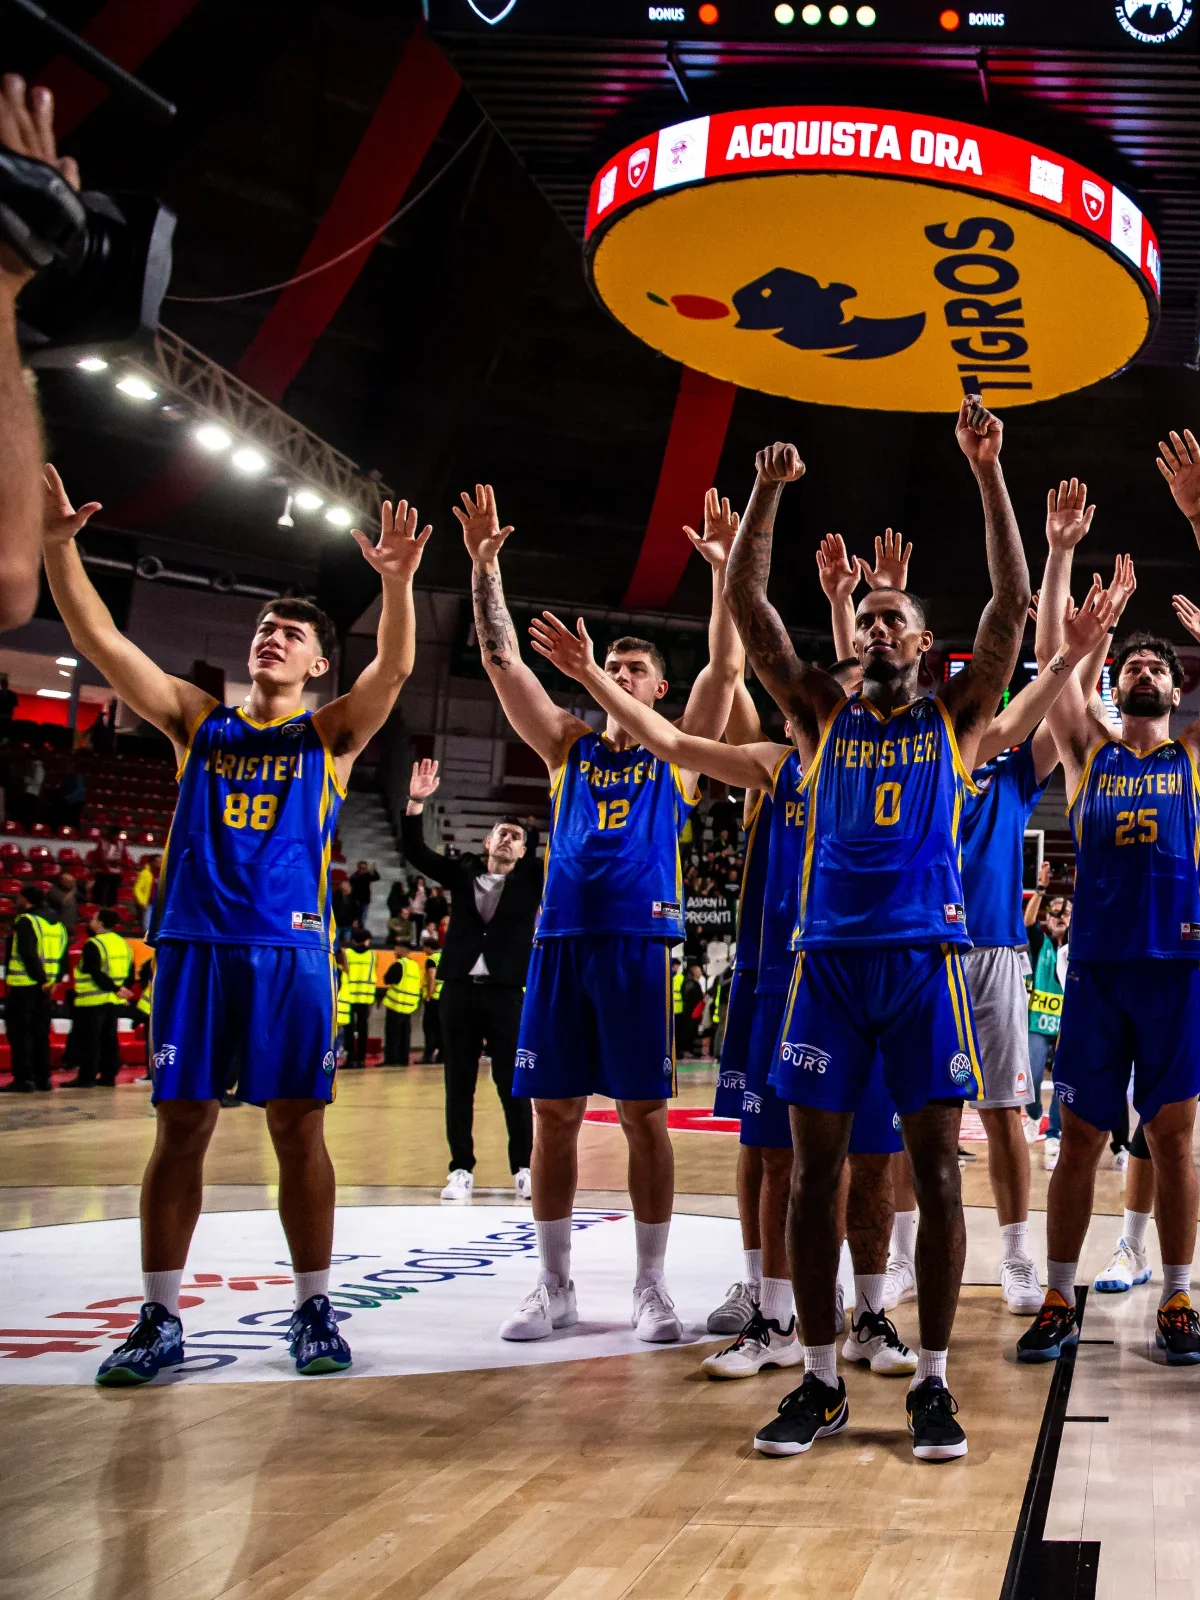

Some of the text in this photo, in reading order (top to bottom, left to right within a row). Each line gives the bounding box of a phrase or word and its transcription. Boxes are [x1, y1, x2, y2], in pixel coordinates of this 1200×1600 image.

[648, 7, 685, 21] BONUS
[968, 12, 1005, 27] BONUS
[725, 120, 983, 176] ACQUISTA ORA
[924, 217, 1033, 396] TIGROS
[1097, 773, 1183, 798] PERISTERI
[222, 793, 278, 831] 88
[597, 799, 630, 830] 12
[875, 782, 902, 826] 0
[1115, 808, 1158, 846] 25
[1030, 992, 1062, 1011] PHO
[1037, 1014, 1061, 1032] 03
[782, 1046, 828, 1074] OURS
